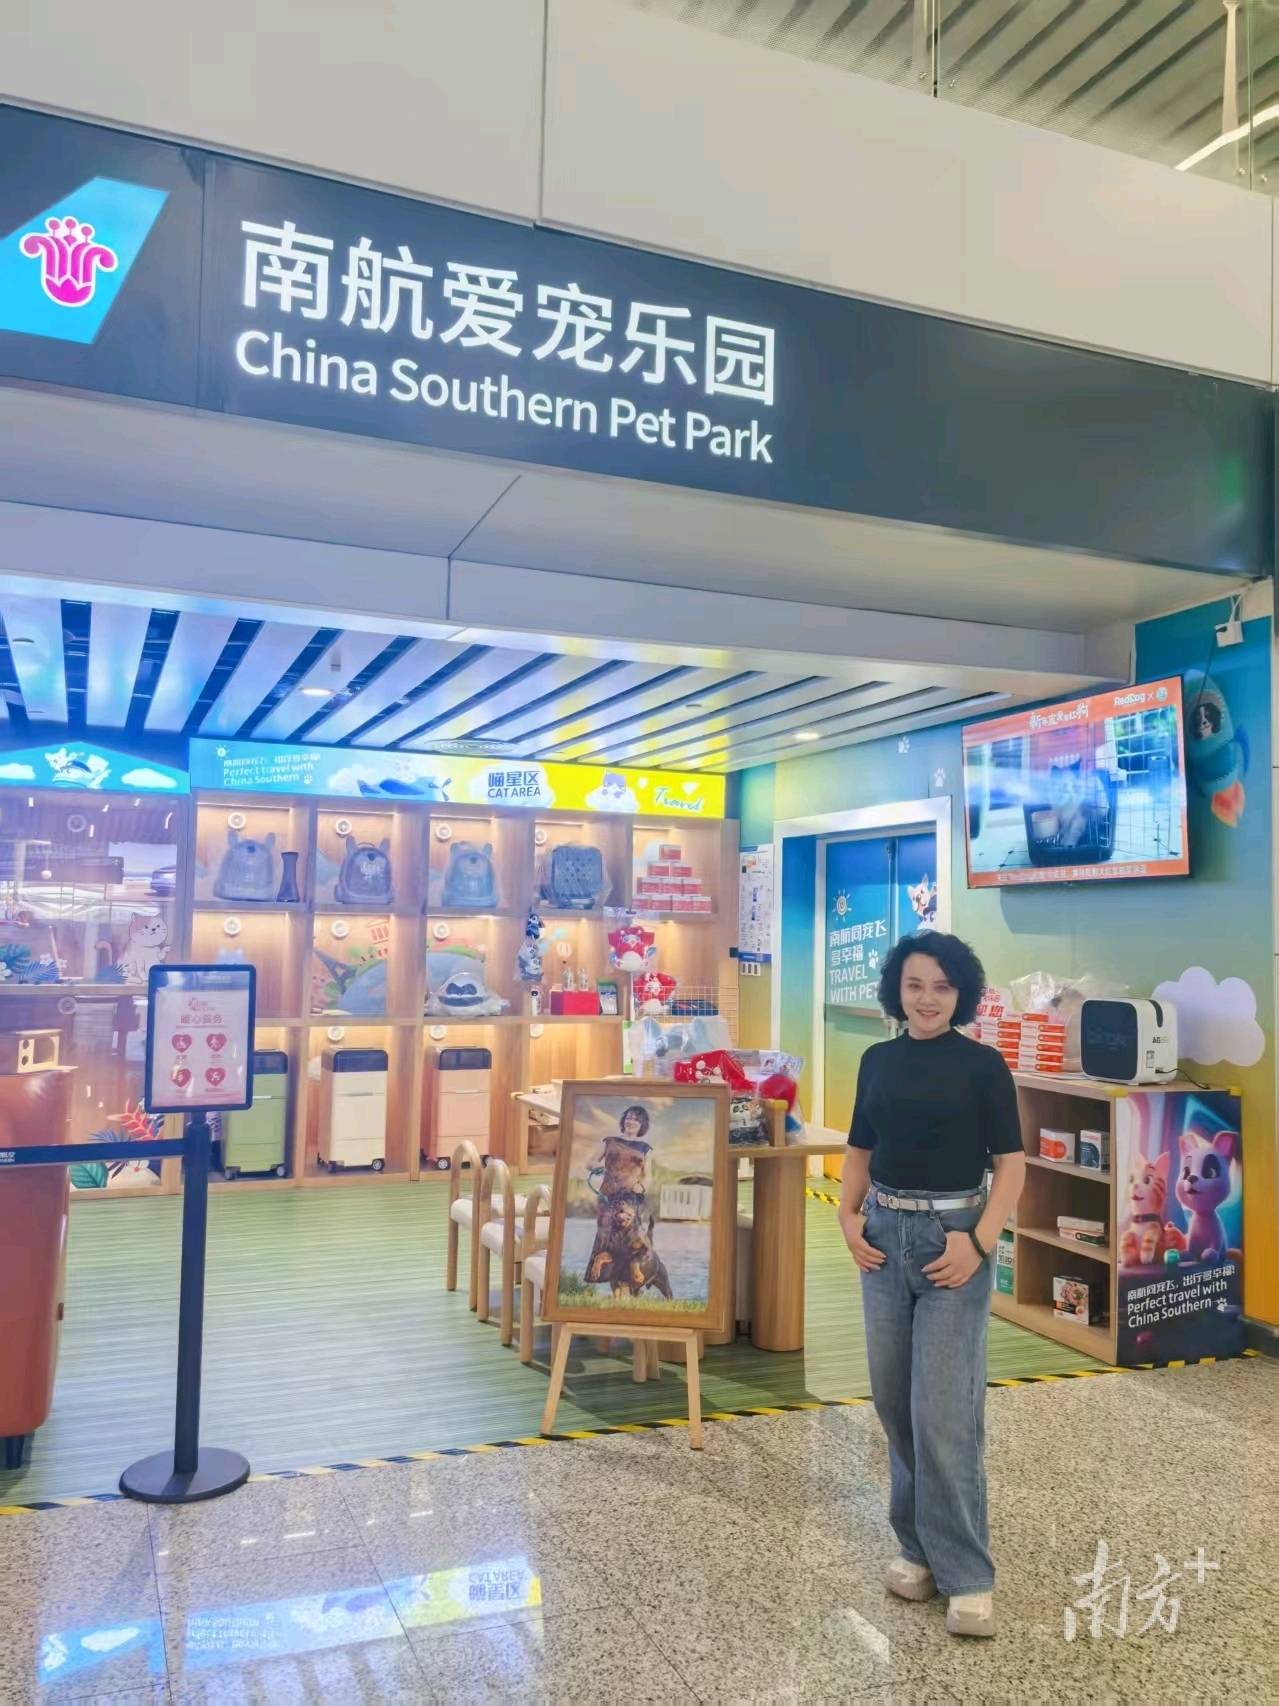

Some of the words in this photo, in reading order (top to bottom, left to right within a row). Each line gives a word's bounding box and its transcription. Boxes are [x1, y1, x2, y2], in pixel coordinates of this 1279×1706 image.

[241, 220, 776, 406] 南航爱宠乐园
[236, 330, 377, 395] China
[389, 358, 598, 433] Southern
[610, 397, 677, 448] Pet
[686, 411, 774, 464] Park
[223, 766, 259, 778] Perfect
[261, 763, 291, 776] travel
[291, 761, 314, 772] with
[223, 776, 254, 786] China
[255, 773, 300, 785] Southern
[488, 771, 540, 788] 喵星区
[488, 788, 509, 798] CAT
[511, 786, 541, 798] AREA
[828, 964, 869, 986] TRAVEL
[829, 985, 857, 1005] WITH
[1127, 1294, 1167, 1315] Perfect
[1168, 1285, 1200, 1304] travel
[1203, 1279, 1228, 1296] with
[1128, 1311, 1160, 1328] China
[1161, 1298, 1212, 1320] Southern
